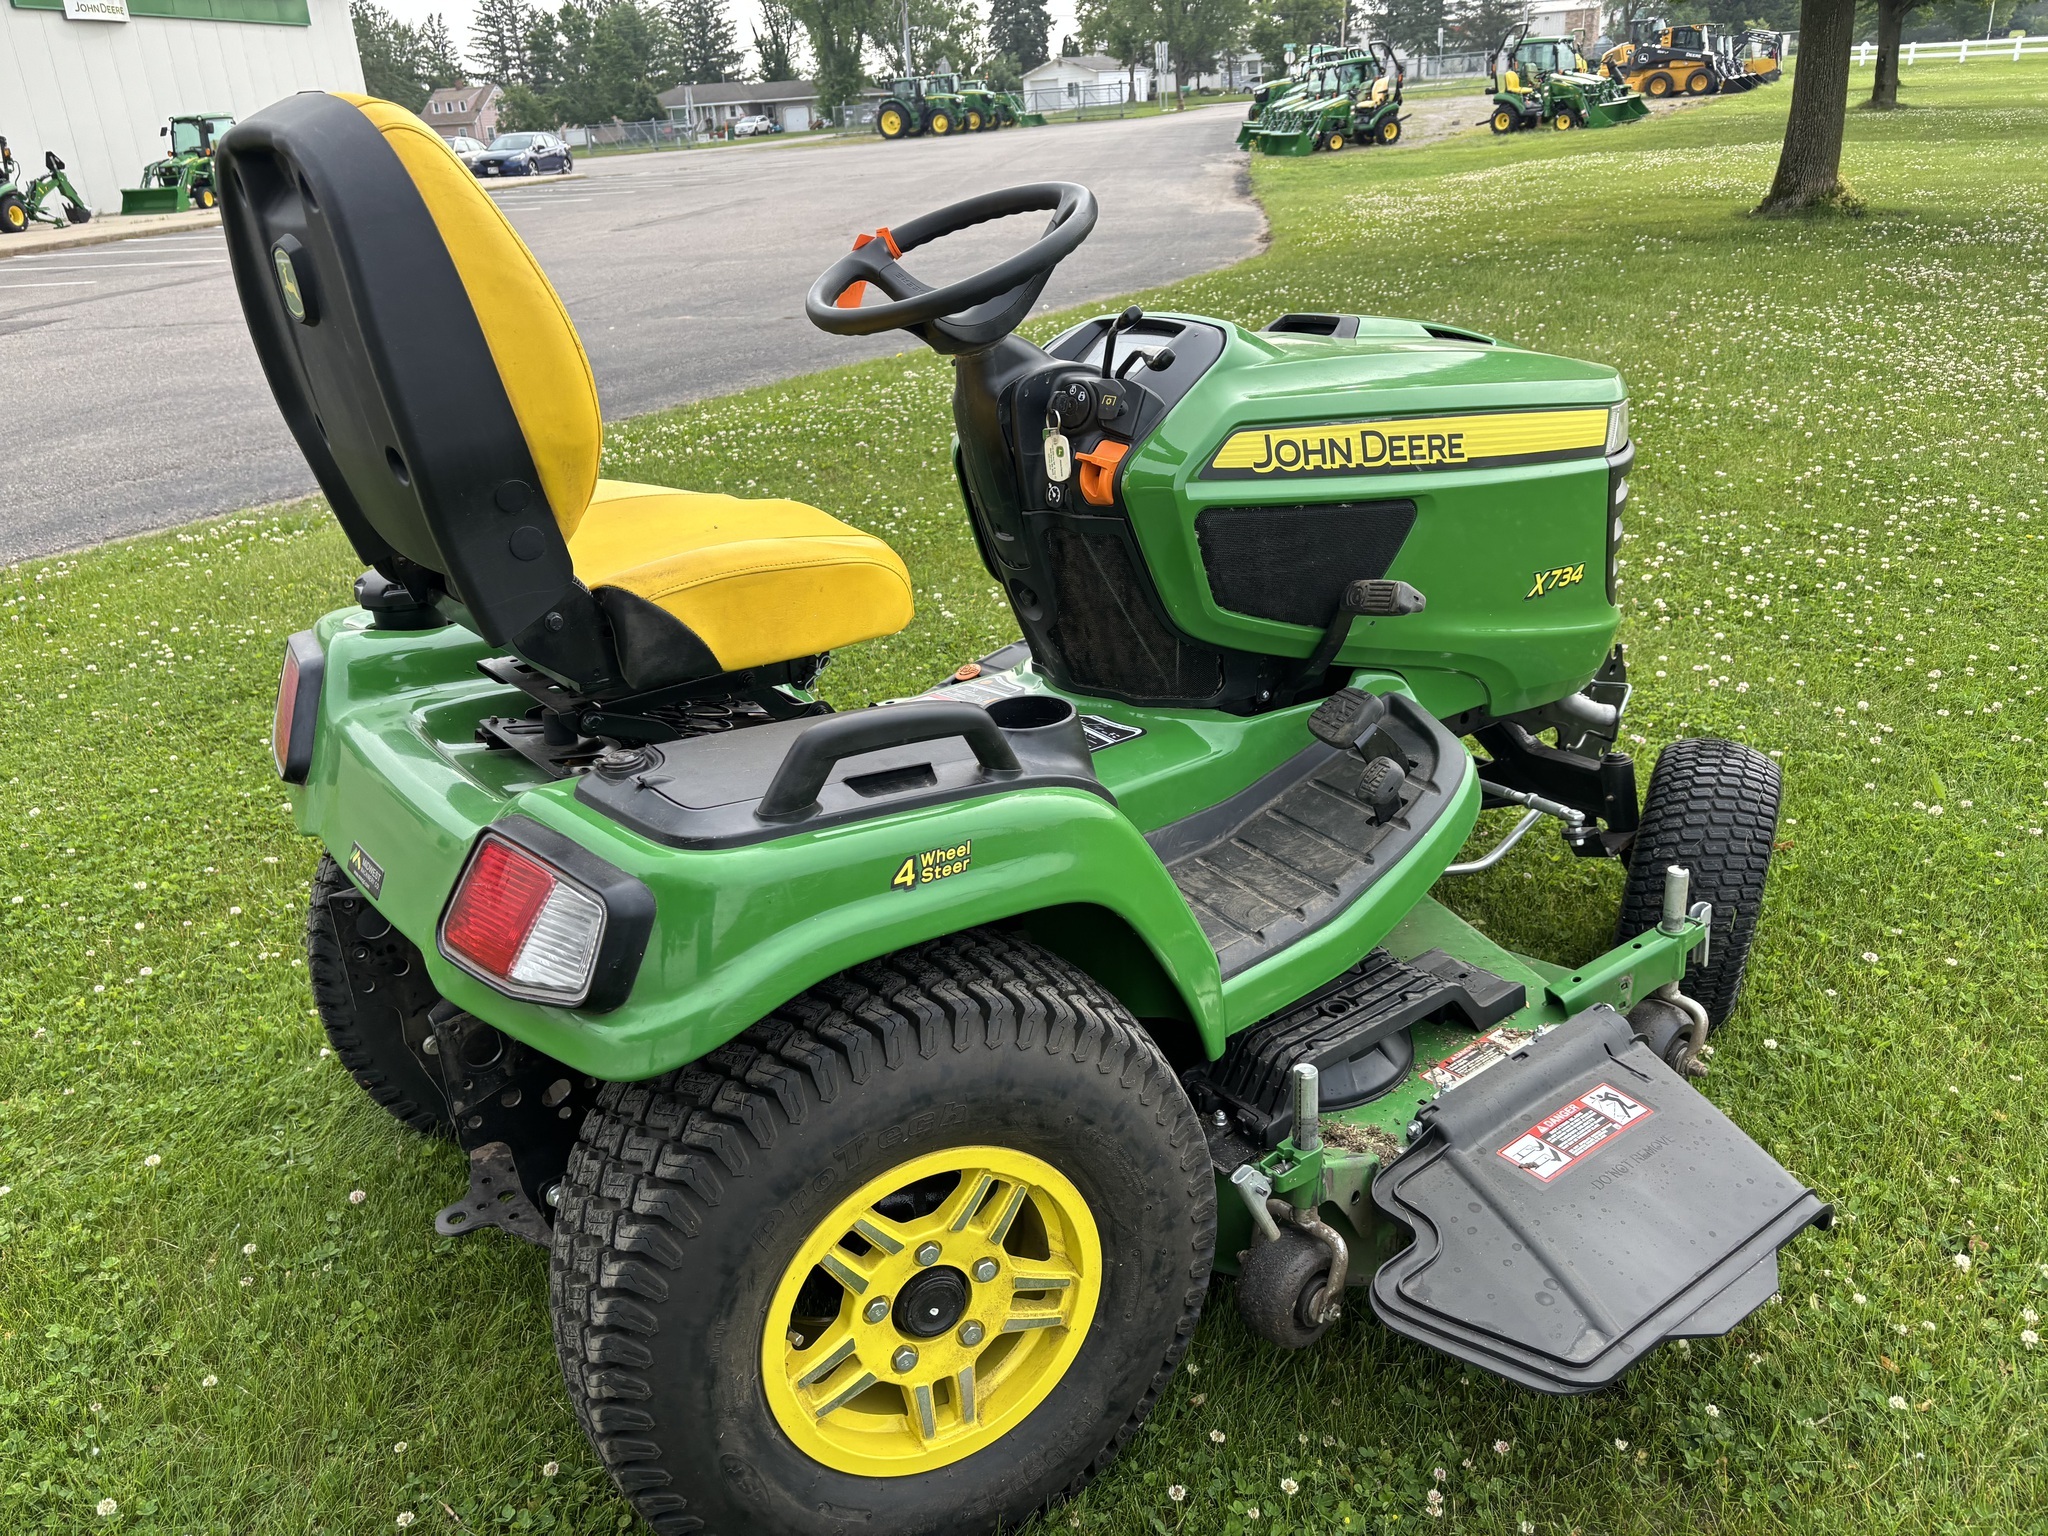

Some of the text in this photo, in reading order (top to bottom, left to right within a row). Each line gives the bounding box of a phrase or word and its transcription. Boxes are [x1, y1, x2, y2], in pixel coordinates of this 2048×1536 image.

[75, 2, 125, 15] JOHN DEERE
[1253, 430, 1466, 469] JOHN DEERE
[1525, 562, 1586, 599] X734
[920, 839, 971, 868] Wheel
[362, 857, 382, 882] MIDWEST
[892, 857, 916, 888] 4
[921, 858, 971, 884] Steer
[1542, 1103, 1580, 1128] DANGER
[752, 1101, 968, 1253] ProTech
[1591, 1174, 1612, 1191] DO
[1611, 1158, 1635, 1179] NOT
[1629, 1135, 1676, 1164] REMOVE
